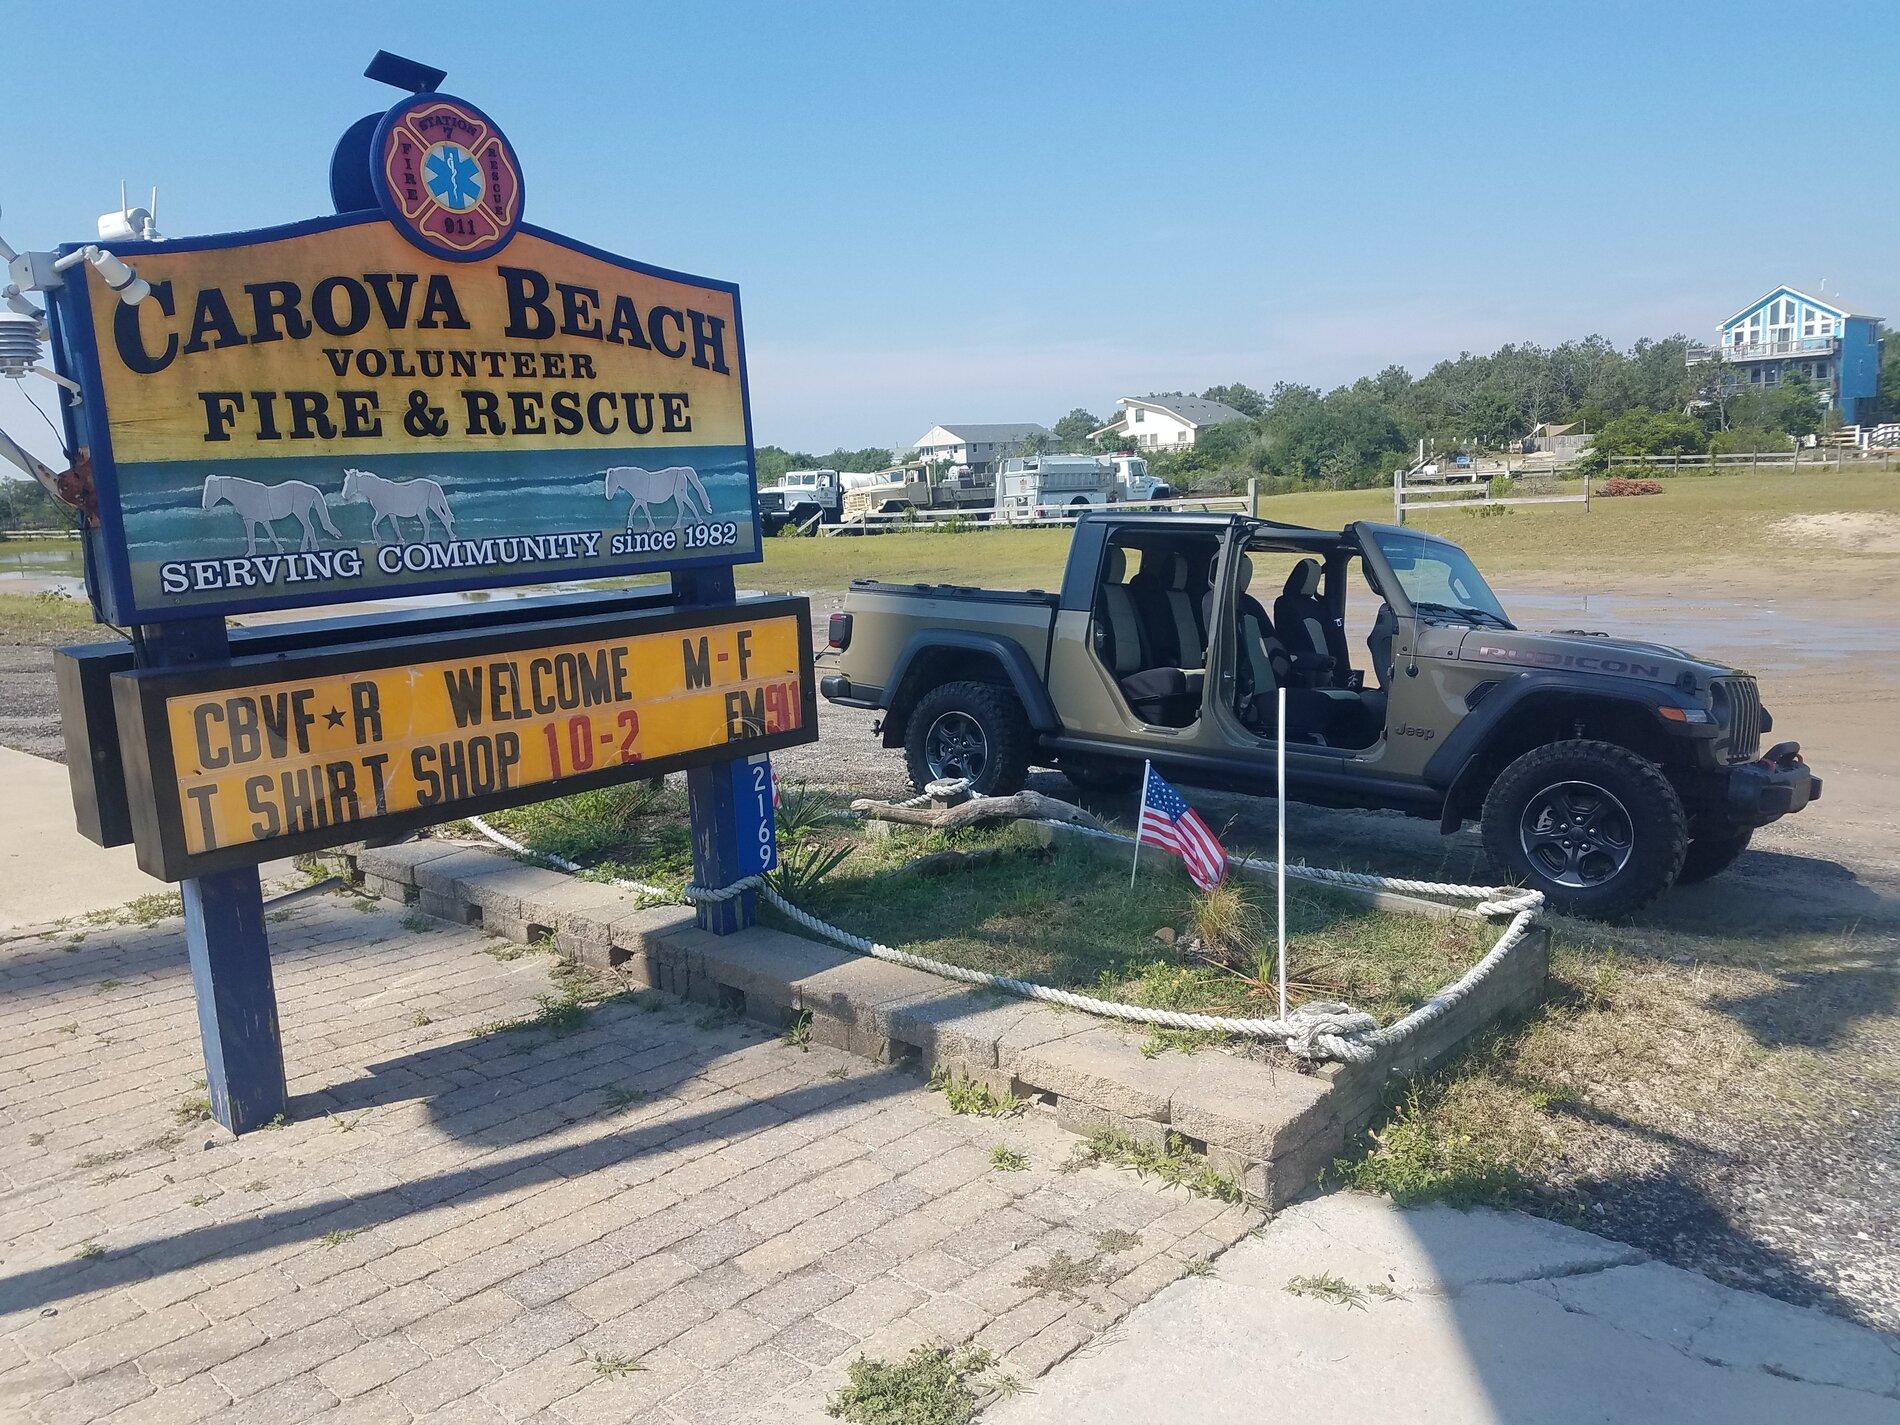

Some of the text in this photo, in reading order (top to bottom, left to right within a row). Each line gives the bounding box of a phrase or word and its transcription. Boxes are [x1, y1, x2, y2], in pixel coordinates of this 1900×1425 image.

[419, 115, 478, 137] STATION
[401, 143, 418, 201] FIRE
[487, 148, 504, 216] RESCUE
[444, 217, 477, 236] 911
[113, 266, 731, 376] CAROVA BEACH
[323, 349, 597, 379] VOLUNTEER
[198, 390, 693, 441] FIRE & RESCUE
[161, 522, 737, 594] SERVING COMMUNITY since 1982
[444, 646, 633, 728] WELCOME
[1479, 646, 1660, 678] RUBICON
[1394, 721, 1435, 741] Jeep
[187, 783, 218, 850] T
[245, 753, 389, 839] SHIRT
[410, 731, 520, 807] SHOP
[543, 709, 643, 779] 10-2
[752, 765, 772, 870] 2169
